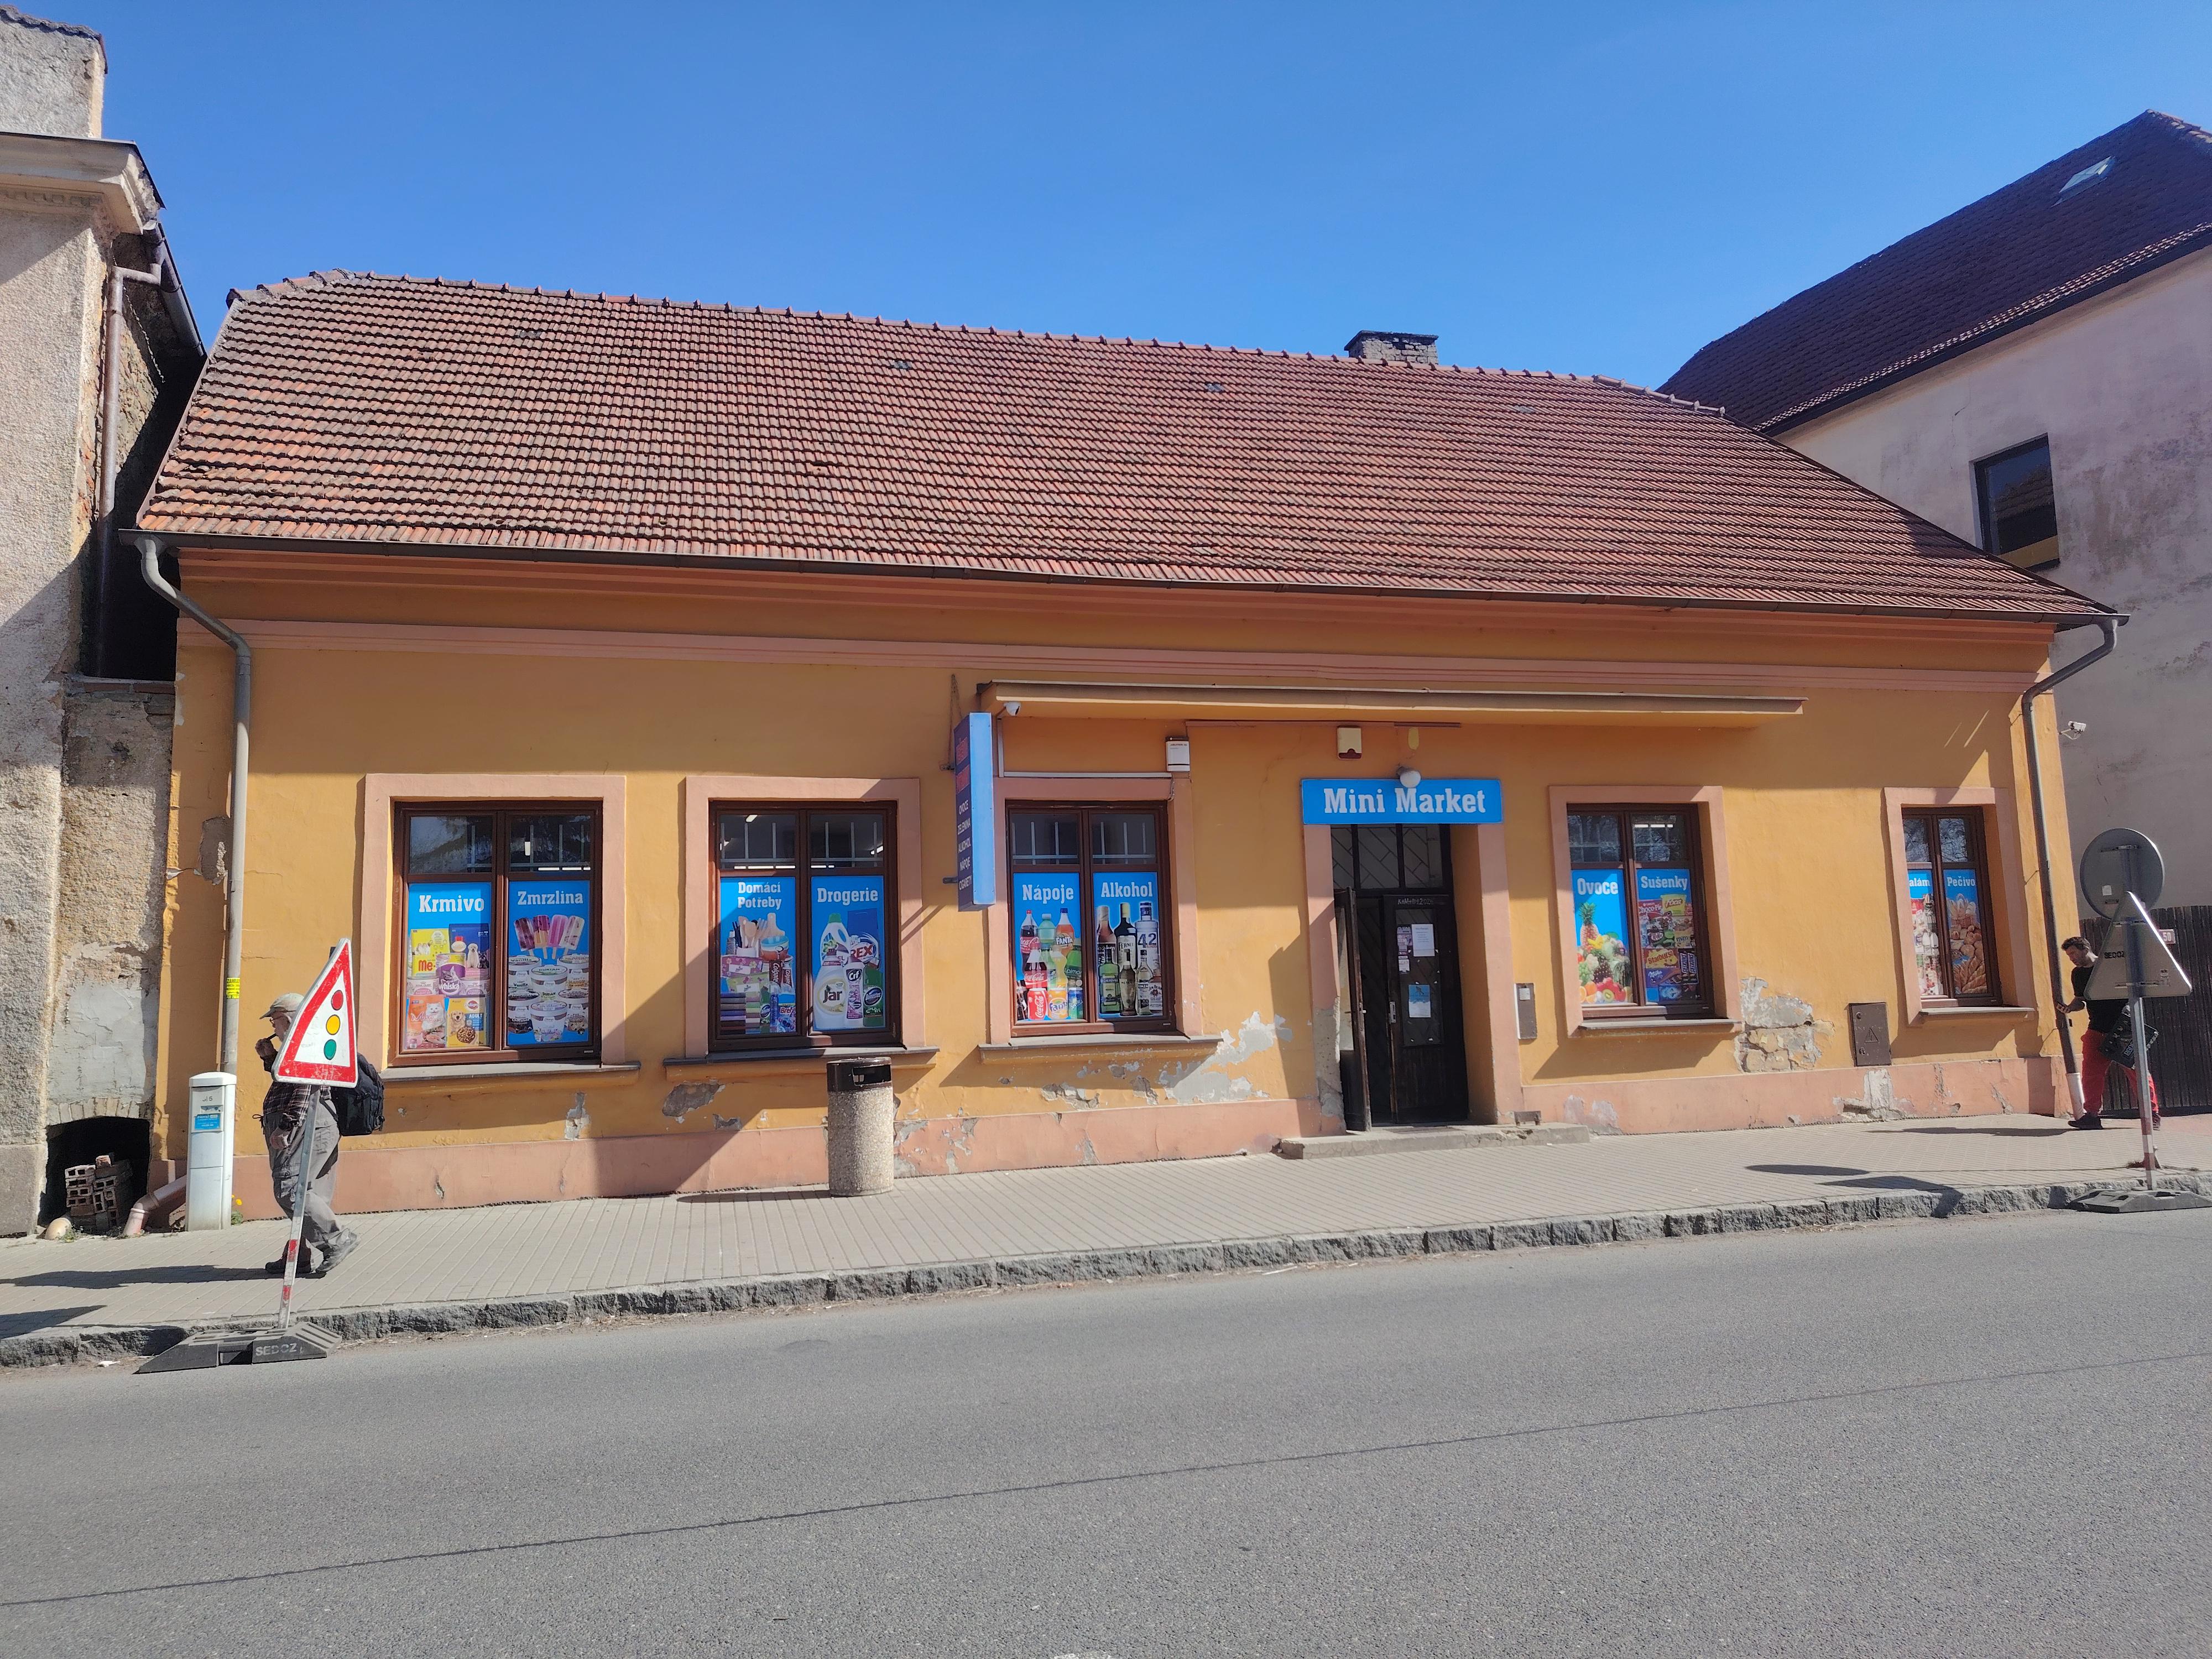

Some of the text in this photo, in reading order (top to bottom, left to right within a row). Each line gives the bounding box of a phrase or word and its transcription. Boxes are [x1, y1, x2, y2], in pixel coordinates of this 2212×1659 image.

[958, 800, 969, 815] OVOCE
[1323, 787, 1486, 813] Mini Market
[957, 818, 971, 835] ZELENINA
[958, 837, 971, 853] ALKOHOL
[959, 857, 971, 872] NÁPOJE
[738, 881, 781, 894] Domácí
[958, 875, 972, 890] CIGARETY
[1577, 878, 1619, 895] Ovoce
[1640, 875, 1688, 891] Sušenky
[1909, 878, 1931, 886] alám
[1947, 875, 1976, 887] Pečivo
[817, 887, 878, 906] Drogerie
[1022, 884, 1074, 904] Nápoje
[1101, 881, 1153, 898] Alkohol
[419, 895, 485, 912] Krmivo
[517, 890, 583, 905] Zmrzlina
[737, 896, 782, 910] Potřeby
[1056, 936, 1073, 945] FANTA
[1138, 933, 1157, 948] 42
[2163, 932, 2172, 942] 50
[848, 971, 860, 980] Cif
